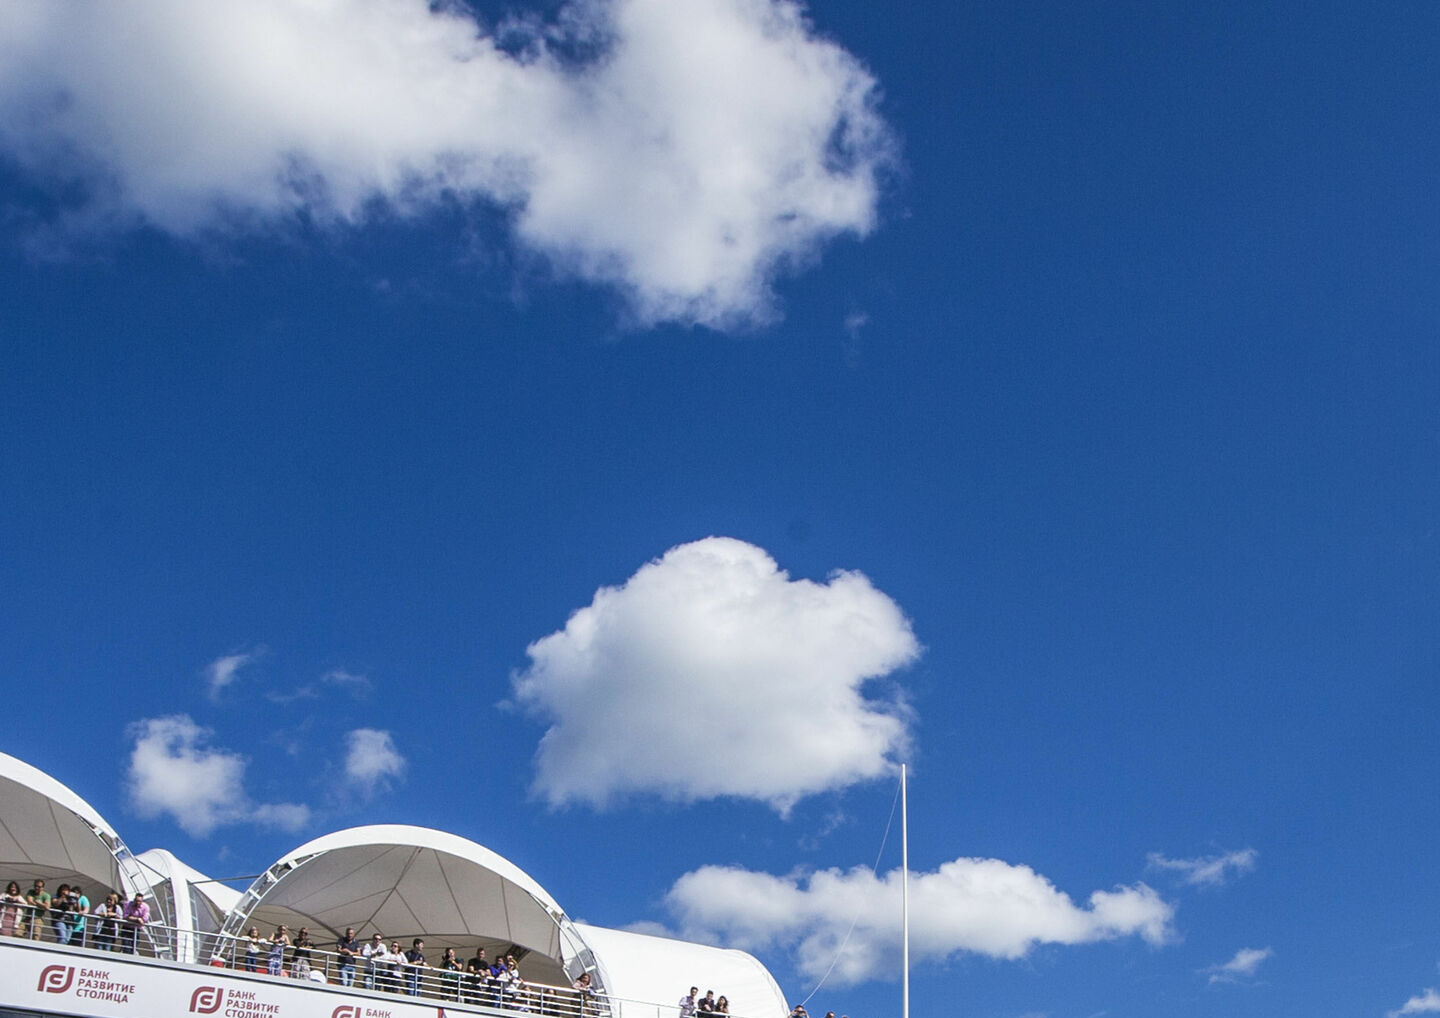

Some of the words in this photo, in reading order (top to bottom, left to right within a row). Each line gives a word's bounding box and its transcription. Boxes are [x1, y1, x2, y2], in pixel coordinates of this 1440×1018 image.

[80, 968, 110, 980] БАНК
[78, 979, 135, 994] РАЗВИТИЕ
[76, 989, 129, 1003] СТОЛИЦА
[228, 989, 256, 1001] БАНК
[226, 999, 280, 1014] РАЗВИТИЕ
[365, 1009, 391, 1018] БАНК
